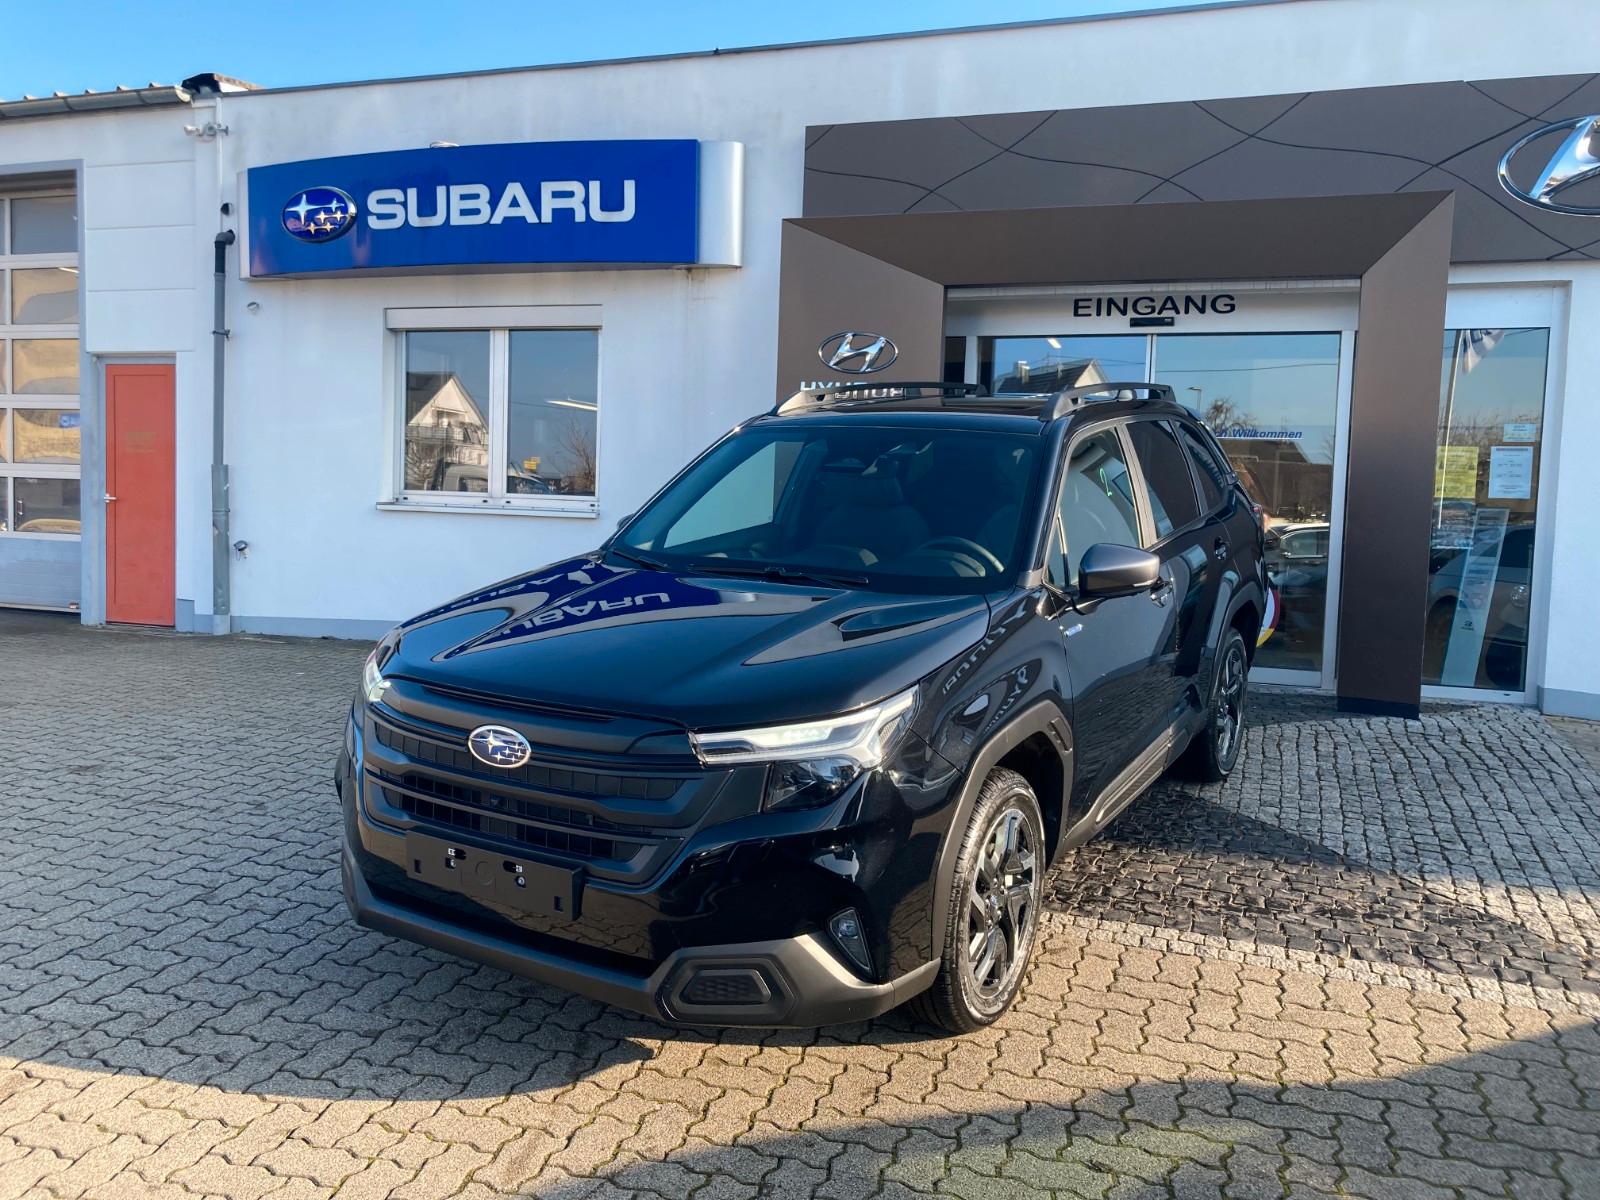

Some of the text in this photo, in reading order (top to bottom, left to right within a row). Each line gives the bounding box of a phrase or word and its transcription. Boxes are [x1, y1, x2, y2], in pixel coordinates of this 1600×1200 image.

[367, 179, 635, 230] SUBARU
[1073, 294, 1236, 317] EINGANG
[1231, 428, 1303, 438] Willkommen
